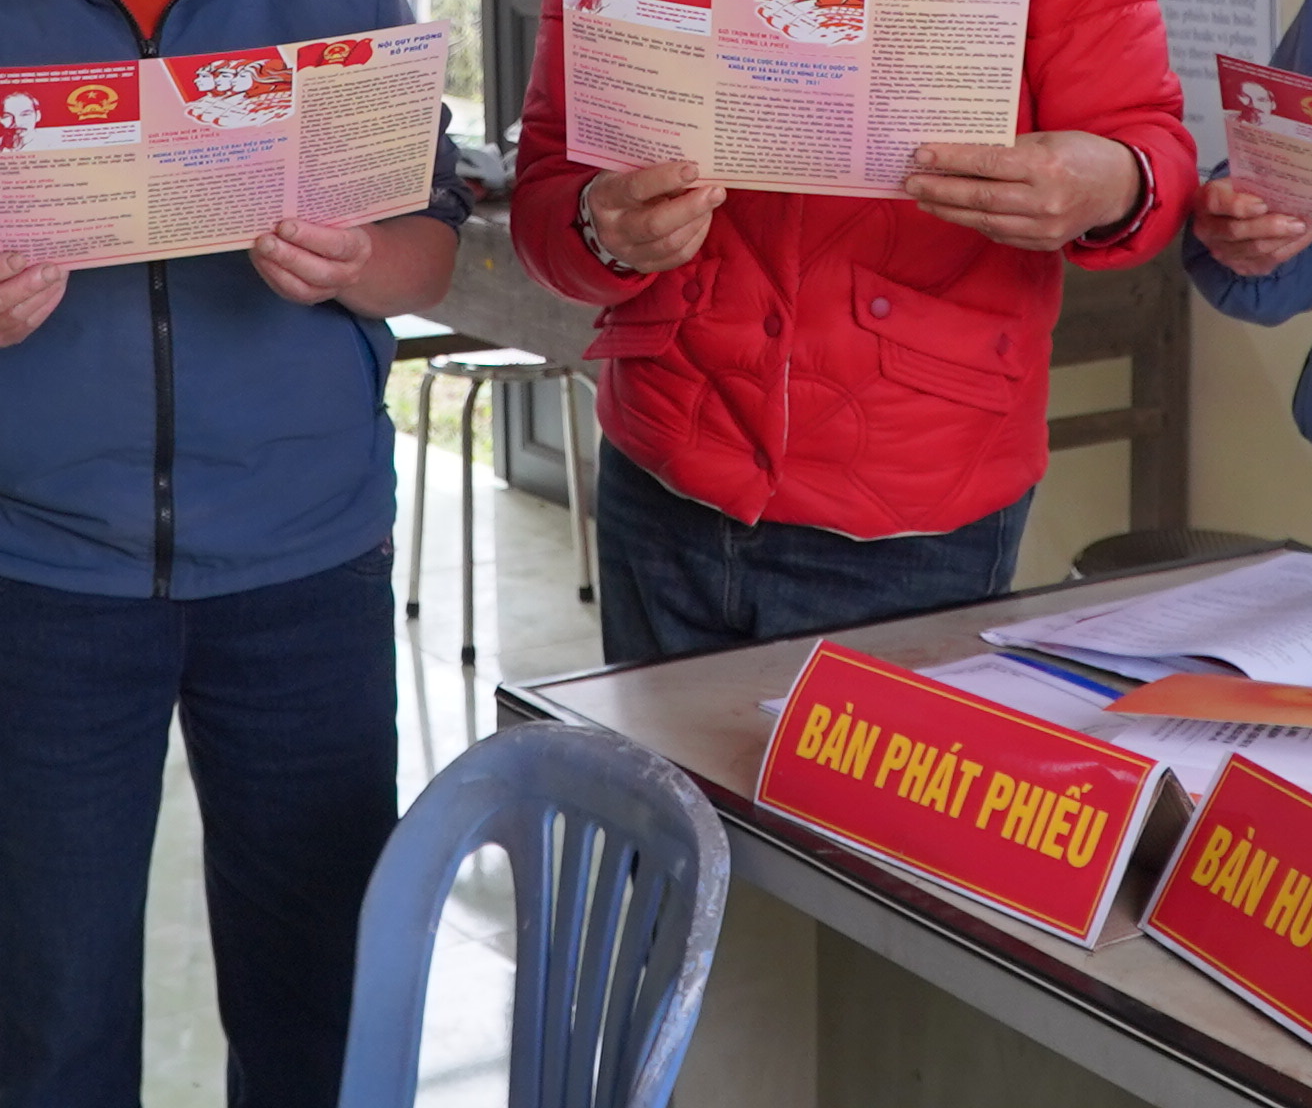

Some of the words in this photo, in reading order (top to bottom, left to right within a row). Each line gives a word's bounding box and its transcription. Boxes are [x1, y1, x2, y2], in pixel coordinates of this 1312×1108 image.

[796, 702, 881, 780] BÀN
[874, 733, 983, 819] PHÁT
[976, 772, 1109, 869] PHIẾU
[1191, 825, 1279, 916] BÀN
